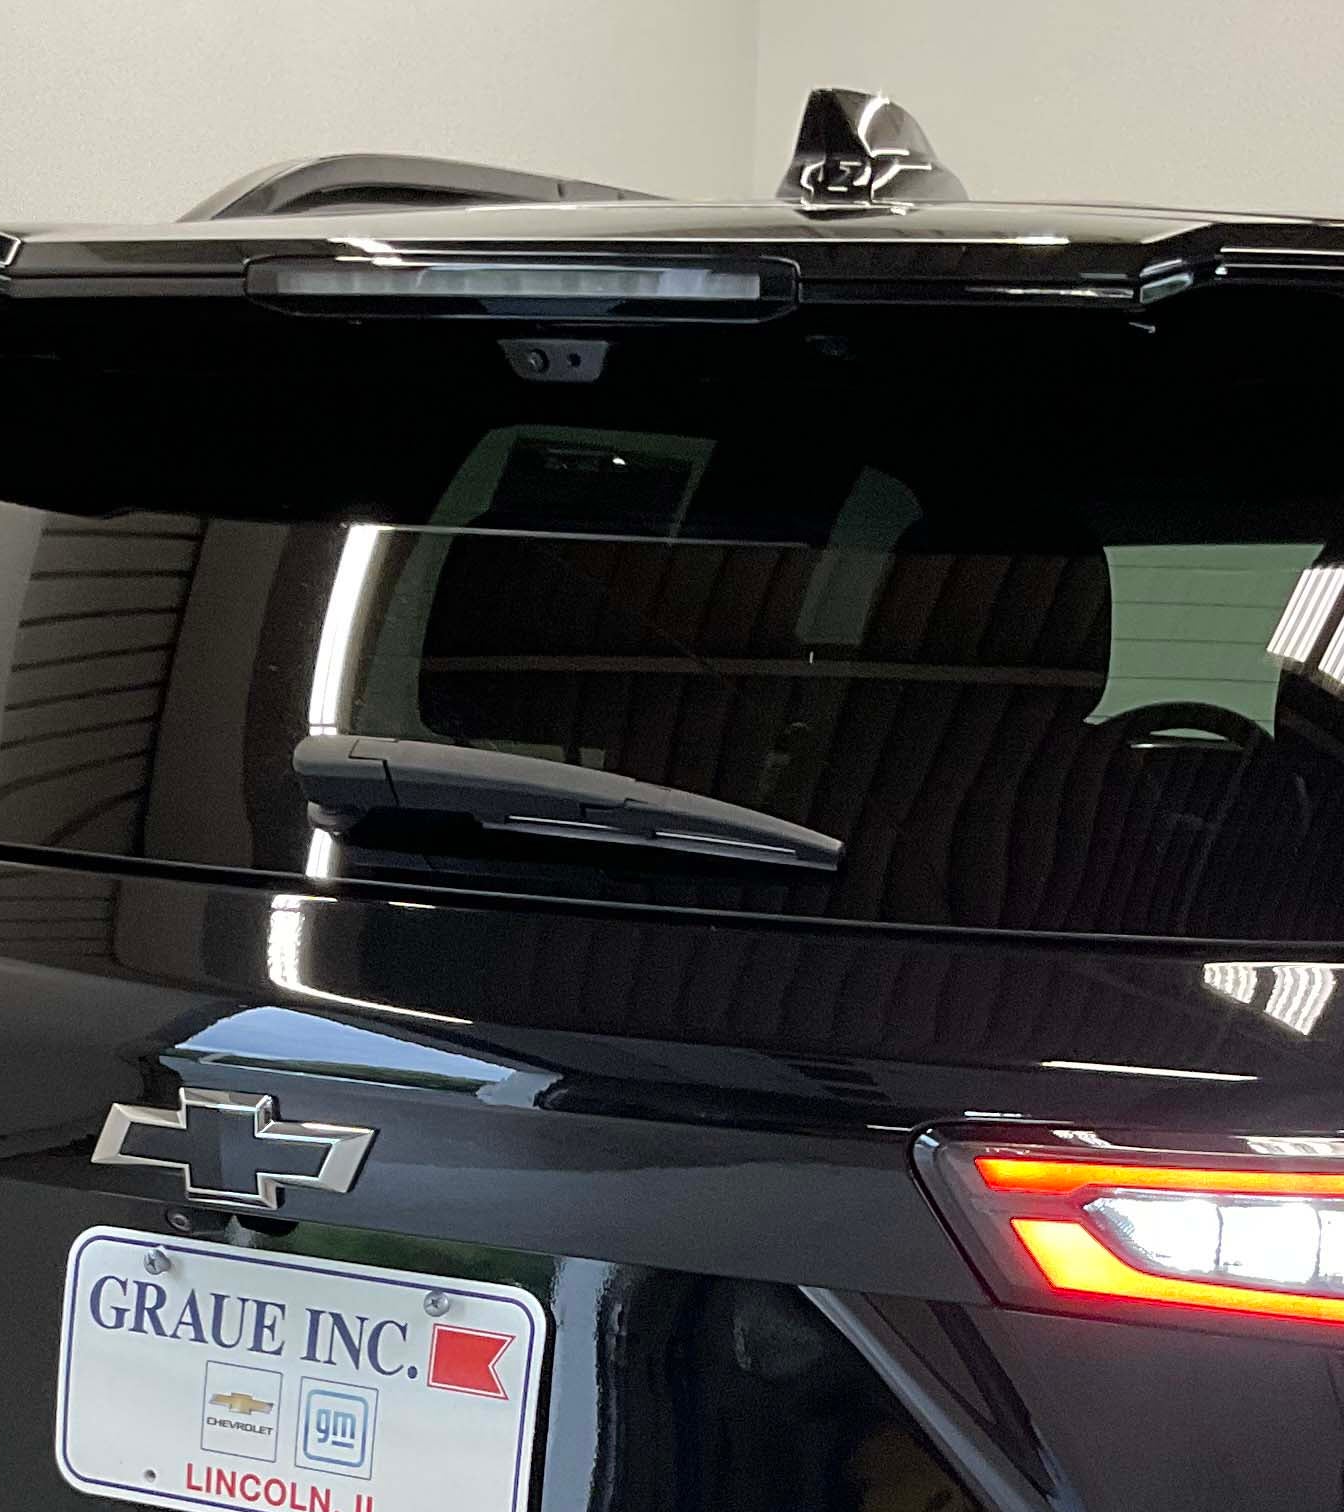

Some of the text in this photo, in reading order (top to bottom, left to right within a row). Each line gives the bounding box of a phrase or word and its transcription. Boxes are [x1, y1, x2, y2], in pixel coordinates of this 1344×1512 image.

[89, 1274, 419, 1380] GRAUE INC.
[206, 1416, 274, 1437] CHEVROLET
[316, 1408, 357, 1449] gm
